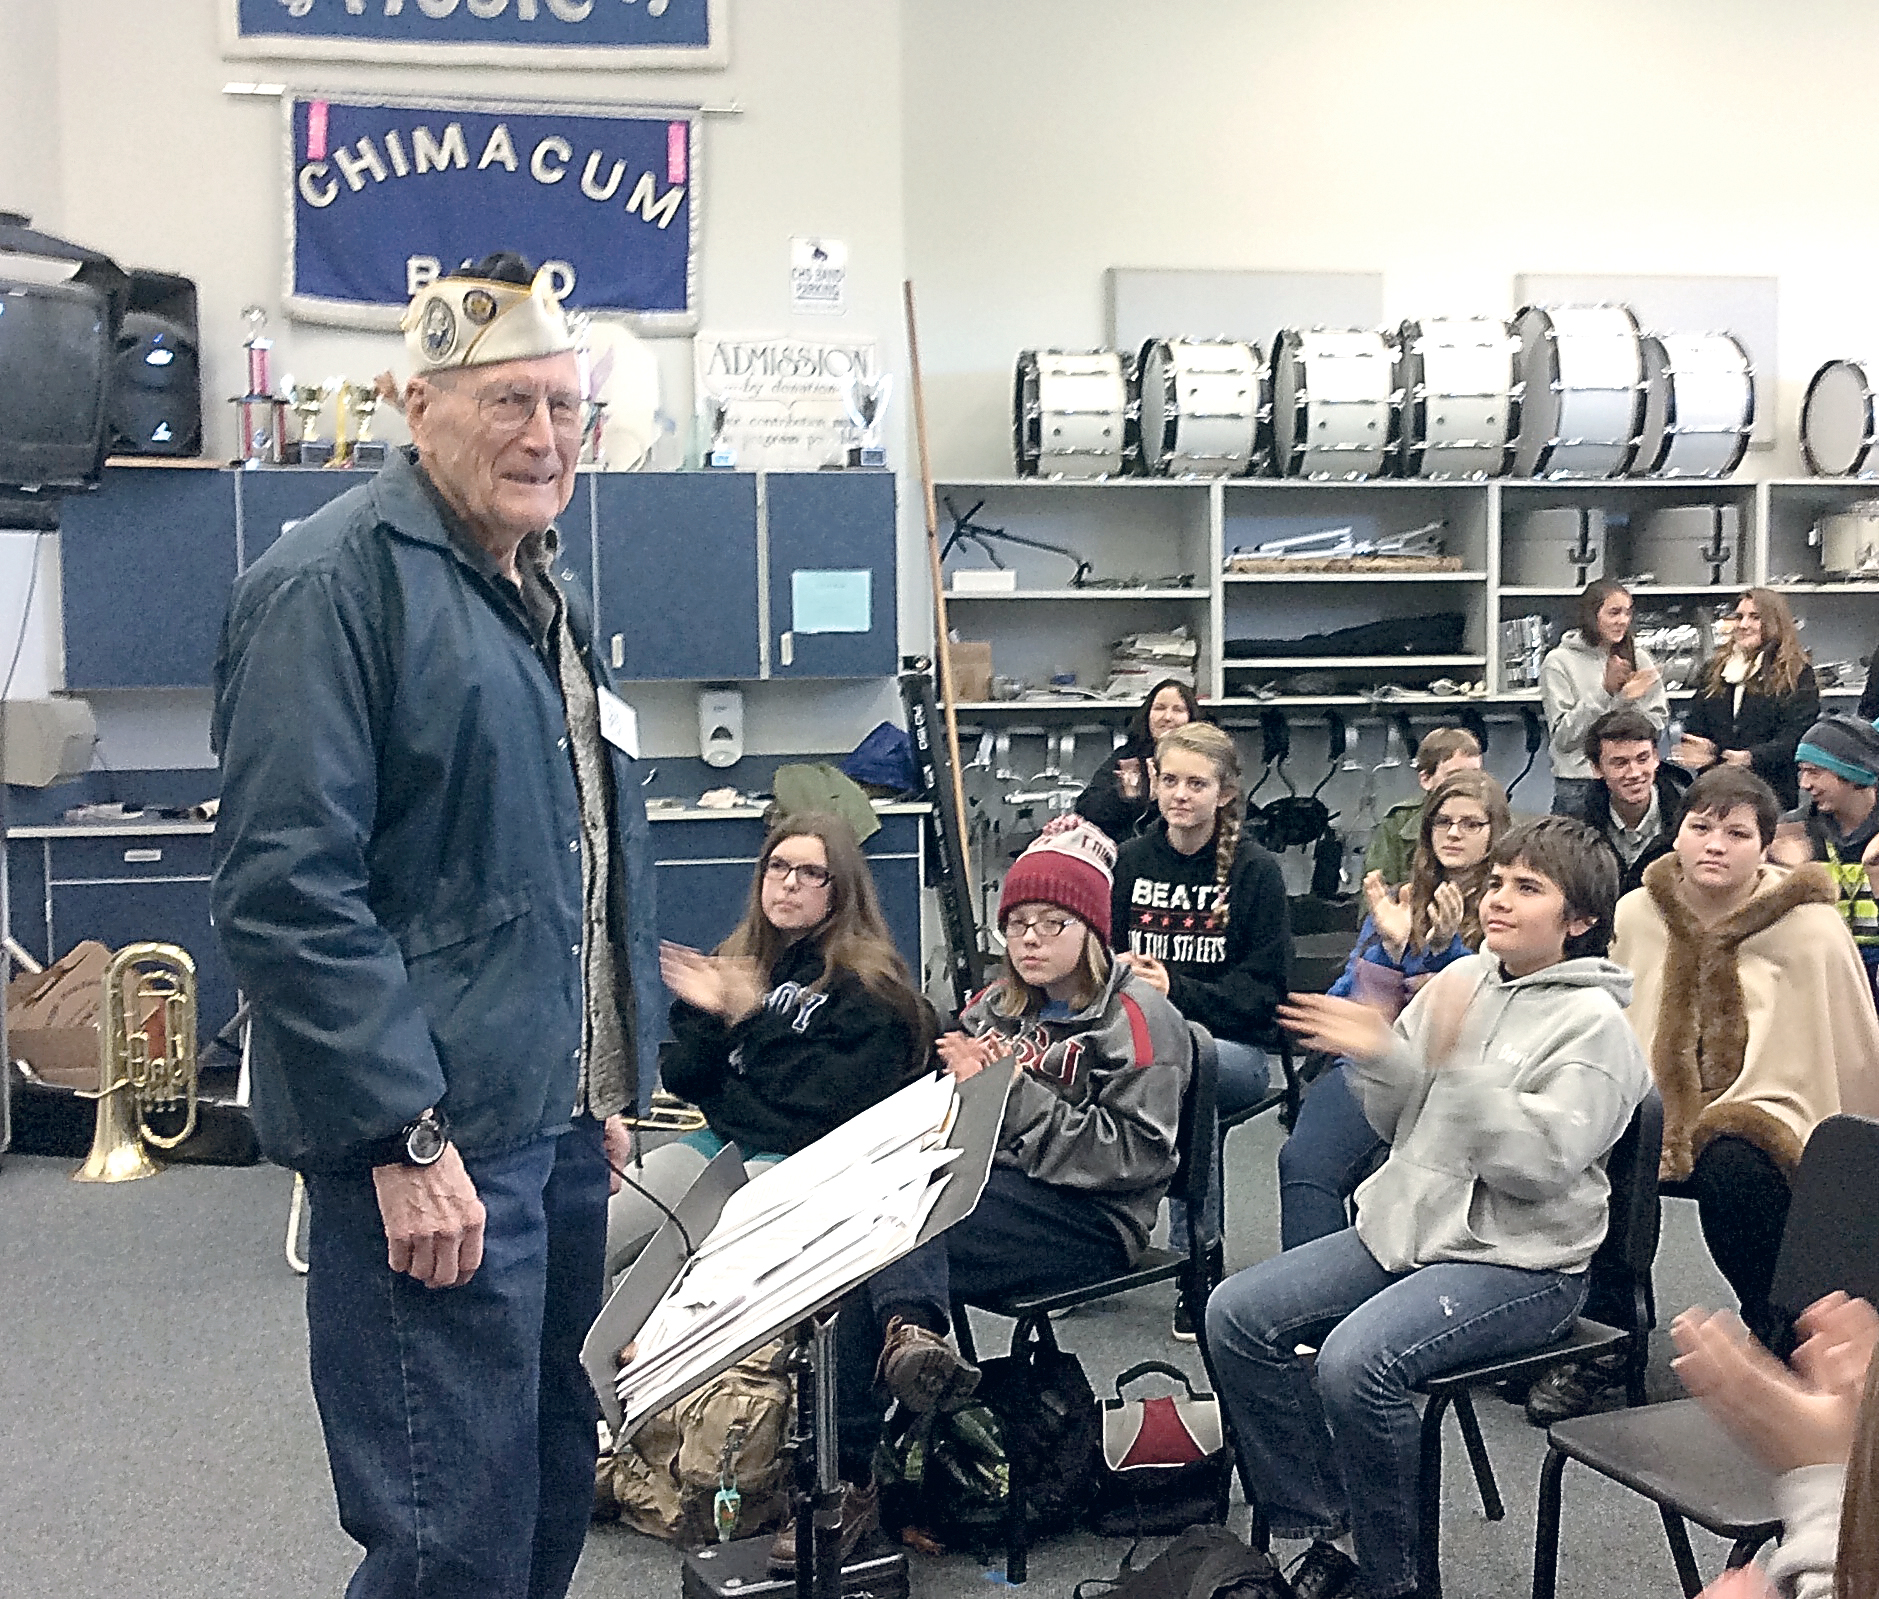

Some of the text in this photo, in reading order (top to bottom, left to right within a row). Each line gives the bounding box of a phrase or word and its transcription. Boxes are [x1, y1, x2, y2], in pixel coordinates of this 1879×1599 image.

[297, 122, 687, 230] CHIMACUM
[407, 254, 576, 302] BD
[706, 340, 872, 378] ADMISSION
[1131, 877, 1231, 911] BEATZ
